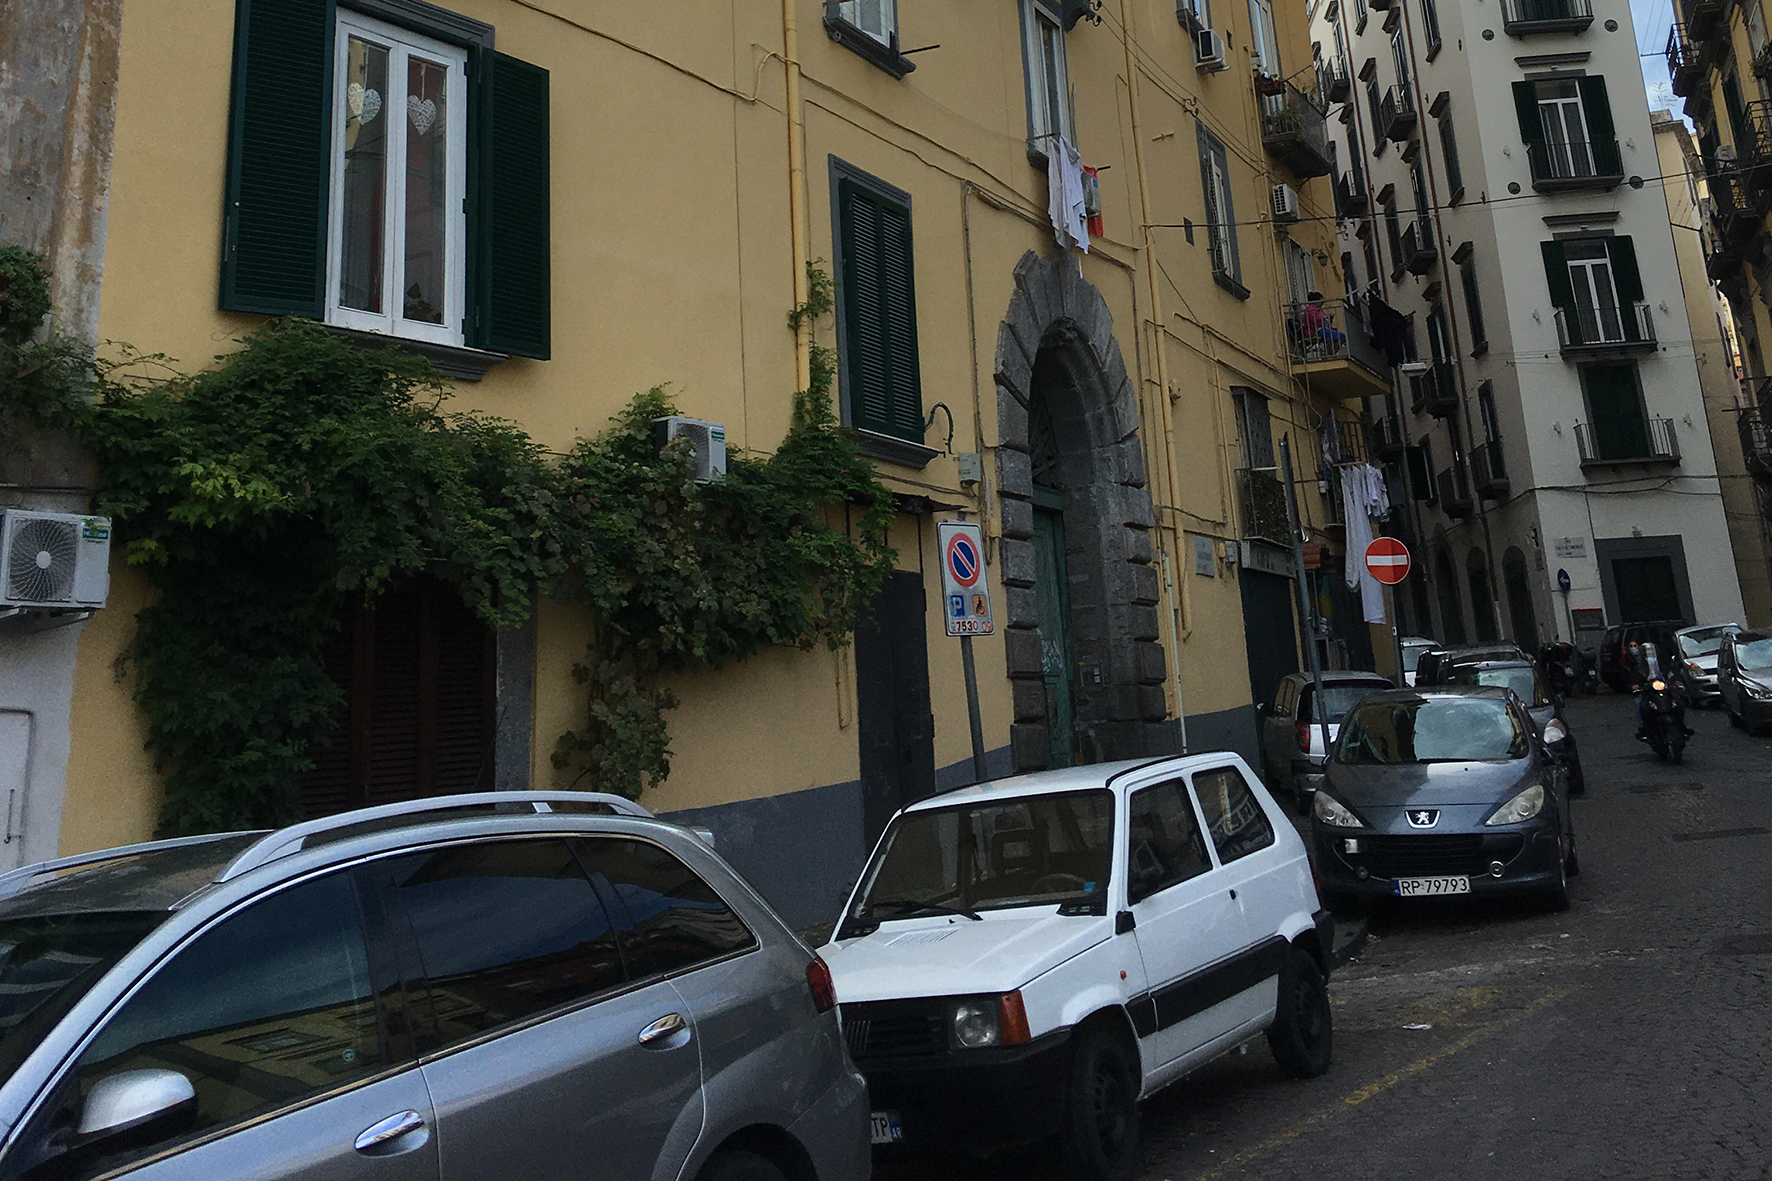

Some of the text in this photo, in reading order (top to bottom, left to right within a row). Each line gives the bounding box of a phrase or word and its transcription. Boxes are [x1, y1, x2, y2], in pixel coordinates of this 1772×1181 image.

[952, 597, 962, 616] P
[951, 620, 979, 632] 27530
[1401, 878, 1467, 894] RP 79793
